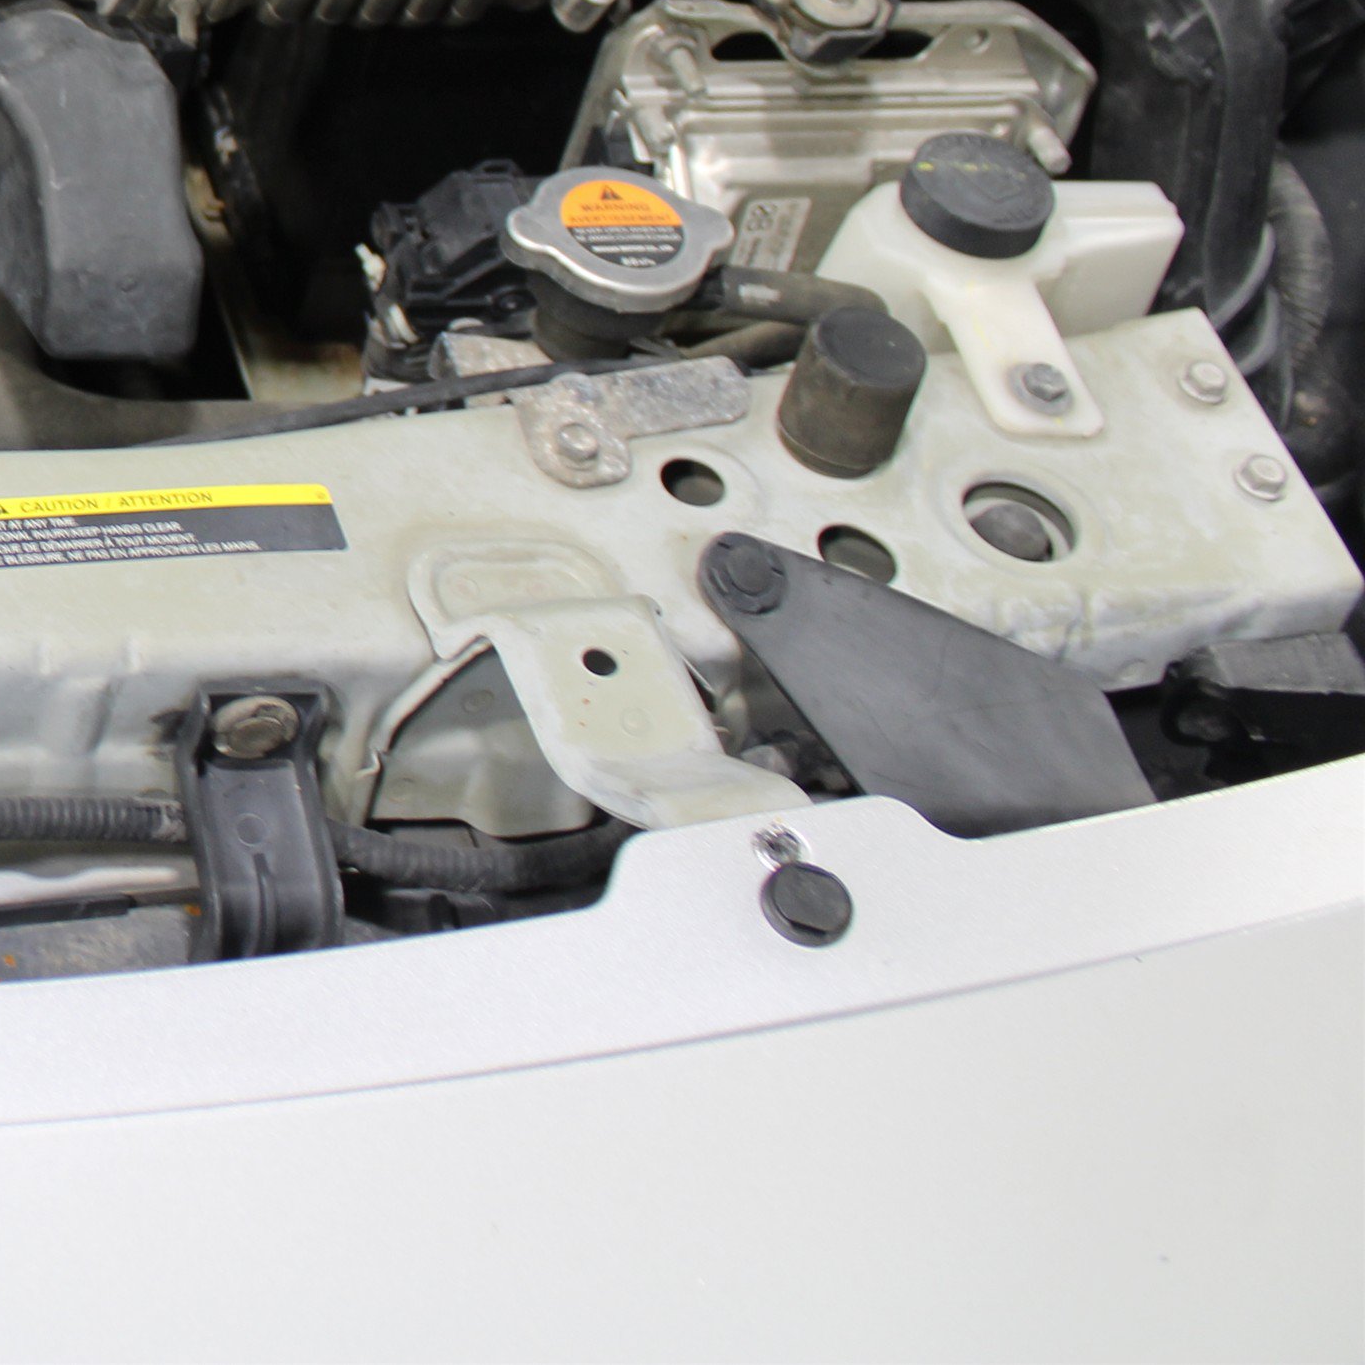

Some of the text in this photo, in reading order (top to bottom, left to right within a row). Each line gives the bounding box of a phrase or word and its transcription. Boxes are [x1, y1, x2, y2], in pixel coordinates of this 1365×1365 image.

[579, 203, 651, 212] WARNING
[20, 498, 99, 513] CAUTION
[119, 491, 213, 508] ATTENTION
[6, 519, 24, 531] AT
[22, 517, 49, 530] ANY
[68, 524, 102, 538] KEEP
[100, 522, 144, 536] HANDS
[20, 541, 42, 553] DE
[39, 537, 105, 552] DÉMARRER
[113, 534, 145, 548] TOUT
[66, 549, 86, 562] NE
[83, 547, 111, 561] PAS
[109, 546, 130, 559] EN
[127, 543, 202, 558] APPROCHER
[198, 541, 223, 554] LES
